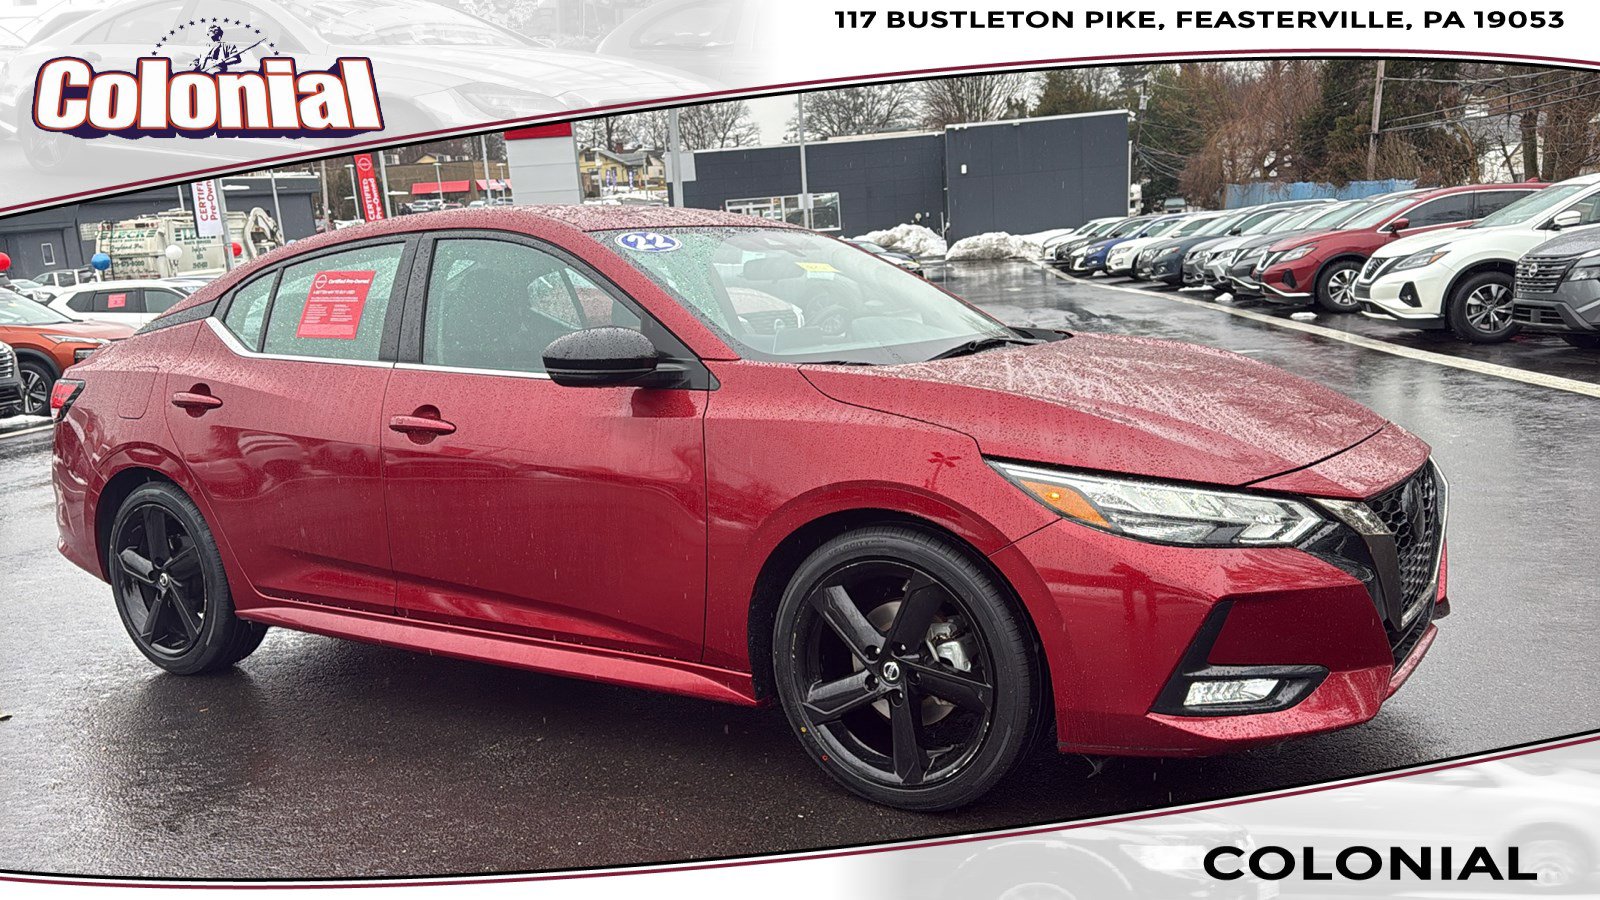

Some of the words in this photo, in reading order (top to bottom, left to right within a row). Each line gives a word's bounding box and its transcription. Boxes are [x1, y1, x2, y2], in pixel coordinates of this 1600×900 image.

[196, 181, 208, 221] CERTIFI
[206, 180, 218, 221] Pre-Own
[362, 178, 376, 220] CERTIFIED
[368, 178, 383, 219] Pre-Owned
[627, 232, 674, 250] 22
